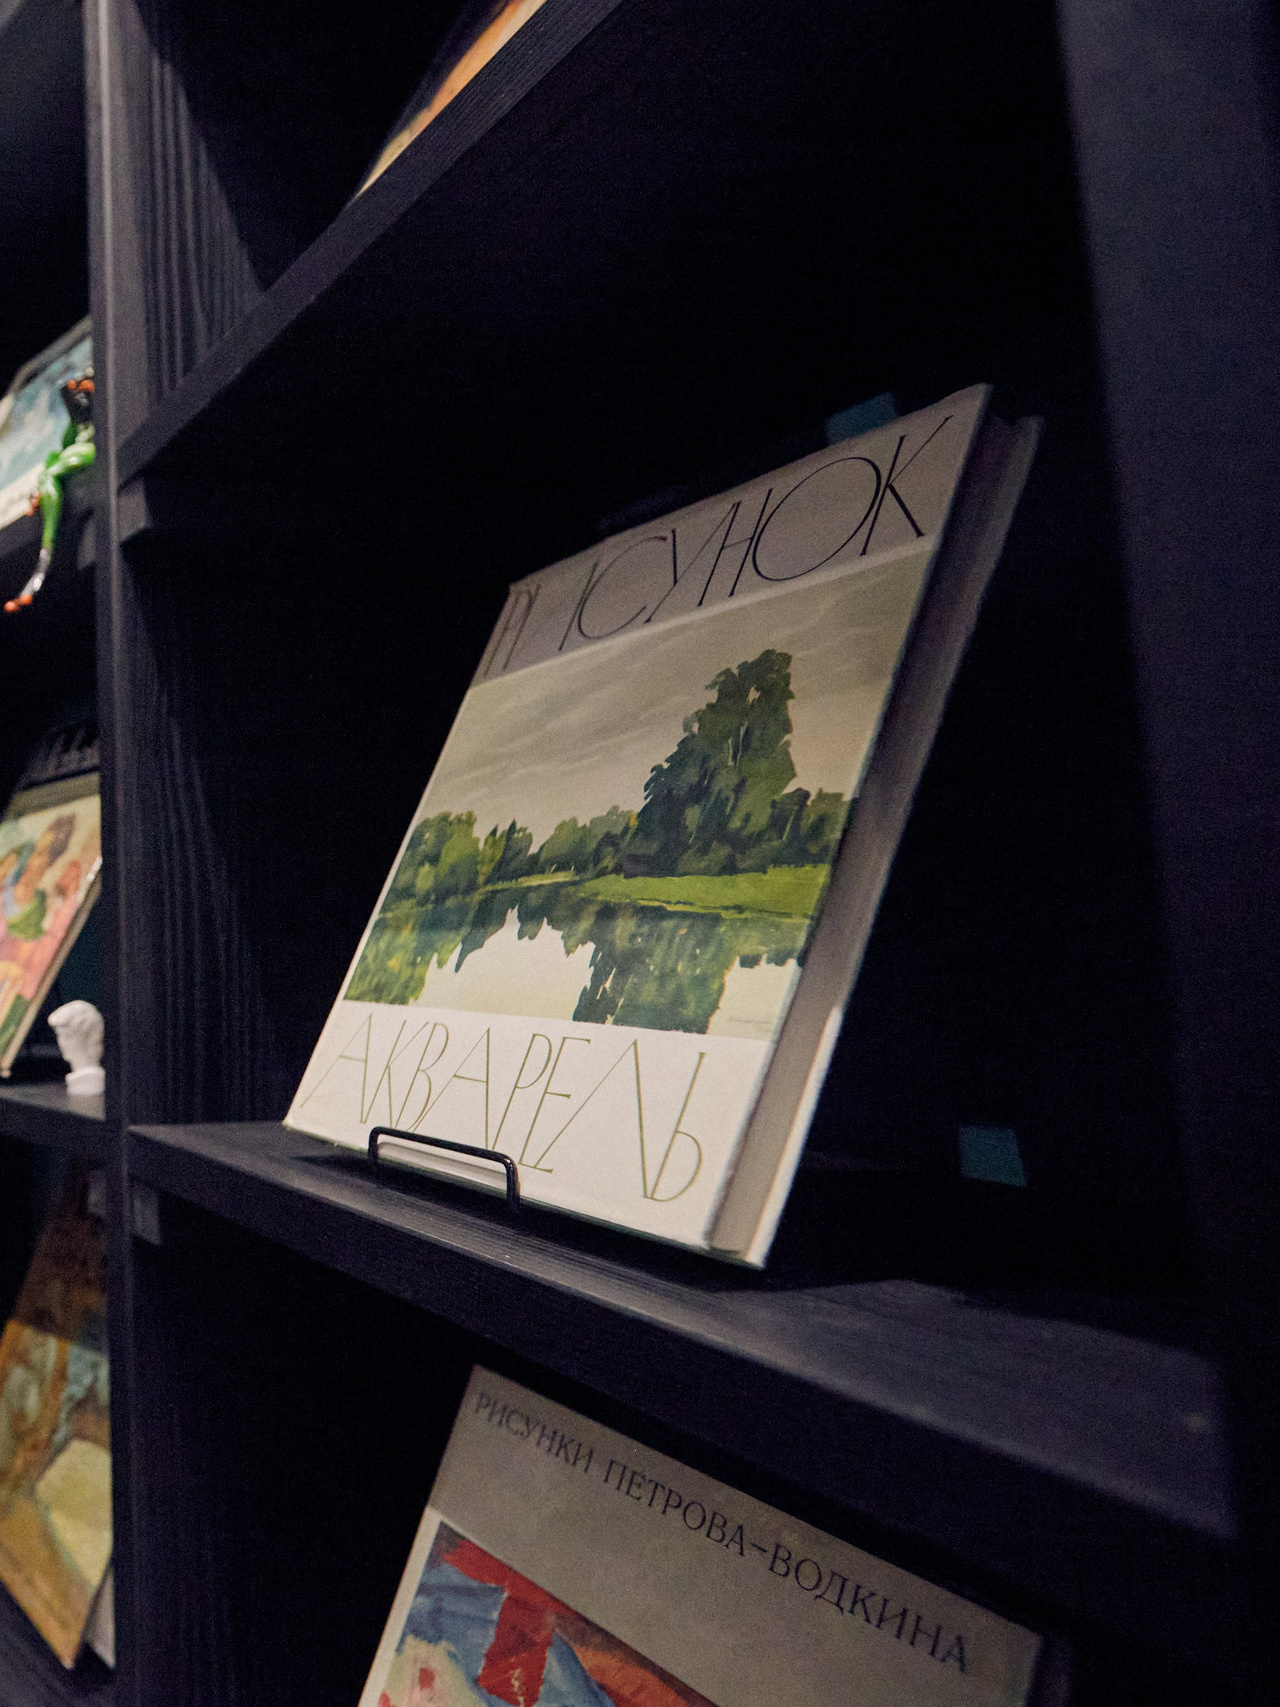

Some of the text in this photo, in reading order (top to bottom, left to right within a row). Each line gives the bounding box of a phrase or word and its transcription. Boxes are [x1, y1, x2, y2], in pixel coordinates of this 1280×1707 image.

[300, 1012, 706, 1202] АКВАРЕЛЬ
[474, 1391, 968, 1674] РИСУНКИ ПЕТРОВА-ВОДКИНА
